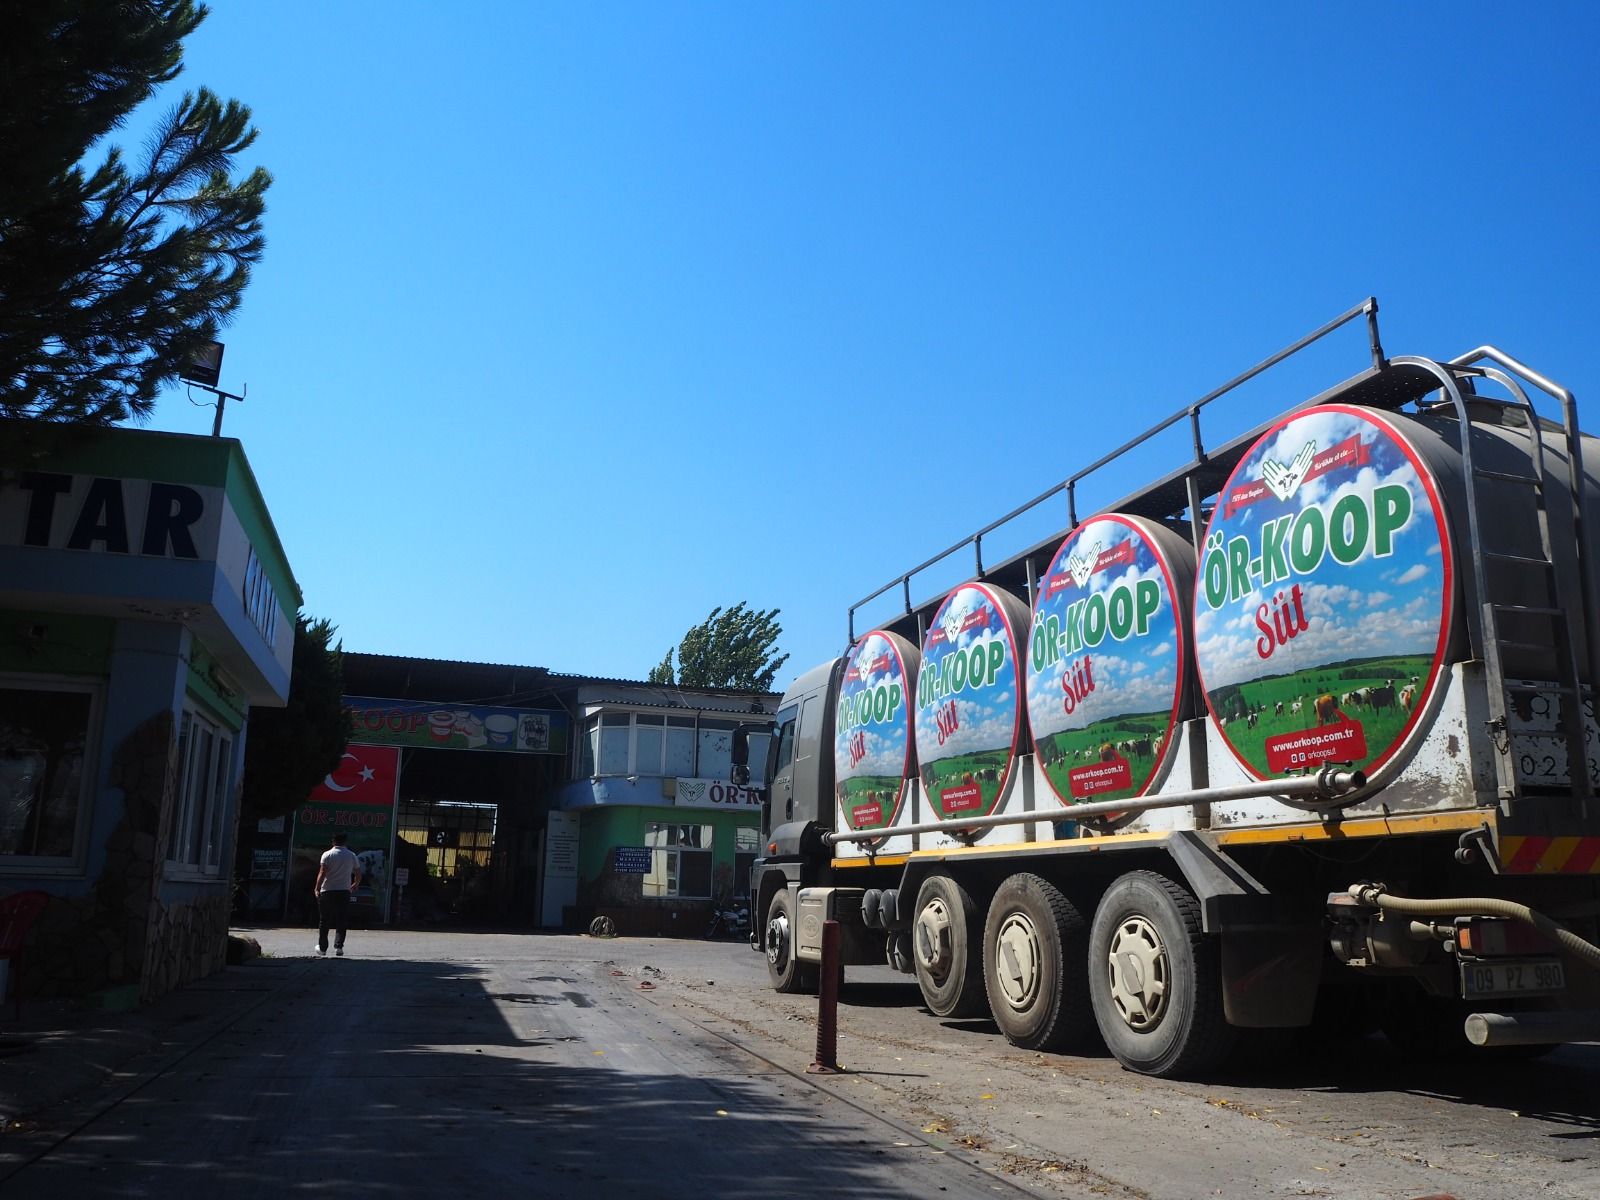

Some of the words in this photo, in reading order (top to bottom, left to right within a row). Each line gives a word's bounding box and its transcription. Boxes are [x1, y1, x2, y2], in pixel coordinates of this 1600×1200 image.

[20, 472, 204, 560] TAR
[1204, 484, 1414, 611] ÖR-KOOP
[1032, 579, 1161, 674] ÖR-KOOP
[1255, 583, 1309, 660] Süt
[919, 640, 1006, 711] ÖR-KOOP
[1062, 654, 1096, 715] Süt
[838, 682, 902, 737] ÖR-KOOP
[936, 698, 959, 746] Süt
[1272, 728, 1355, 752] www.orkoop.com.tr
[300, 805, 389, 828] ÖR-KOOP
[1475, 967, 1494, 991] 09
[1505, 966, 1525, 989] PZ
[1535, 964, 1562, 987] 980
